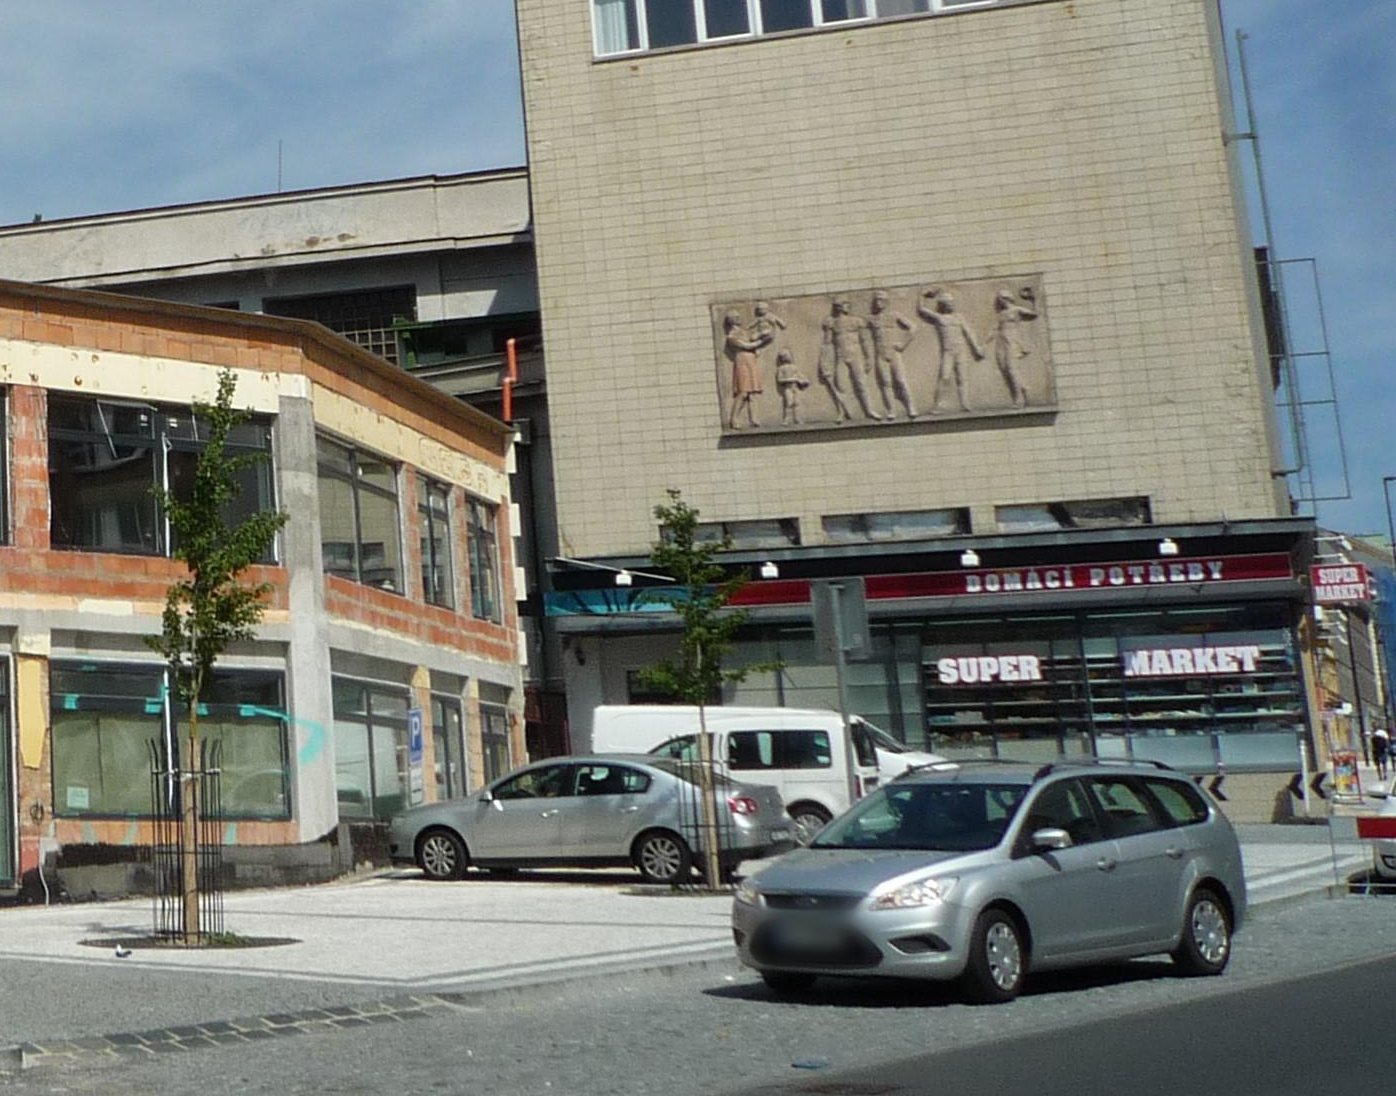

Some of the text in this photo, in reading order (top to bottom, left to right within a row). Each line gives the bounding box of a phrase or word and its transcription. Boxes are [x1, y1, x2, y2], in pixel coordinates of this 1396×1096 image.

[1317, 568, 1359, 584] SUPER
[1315, 584, 1365, 601] MARKET
[937, 645, 1260, 684] SUPER MARKET
